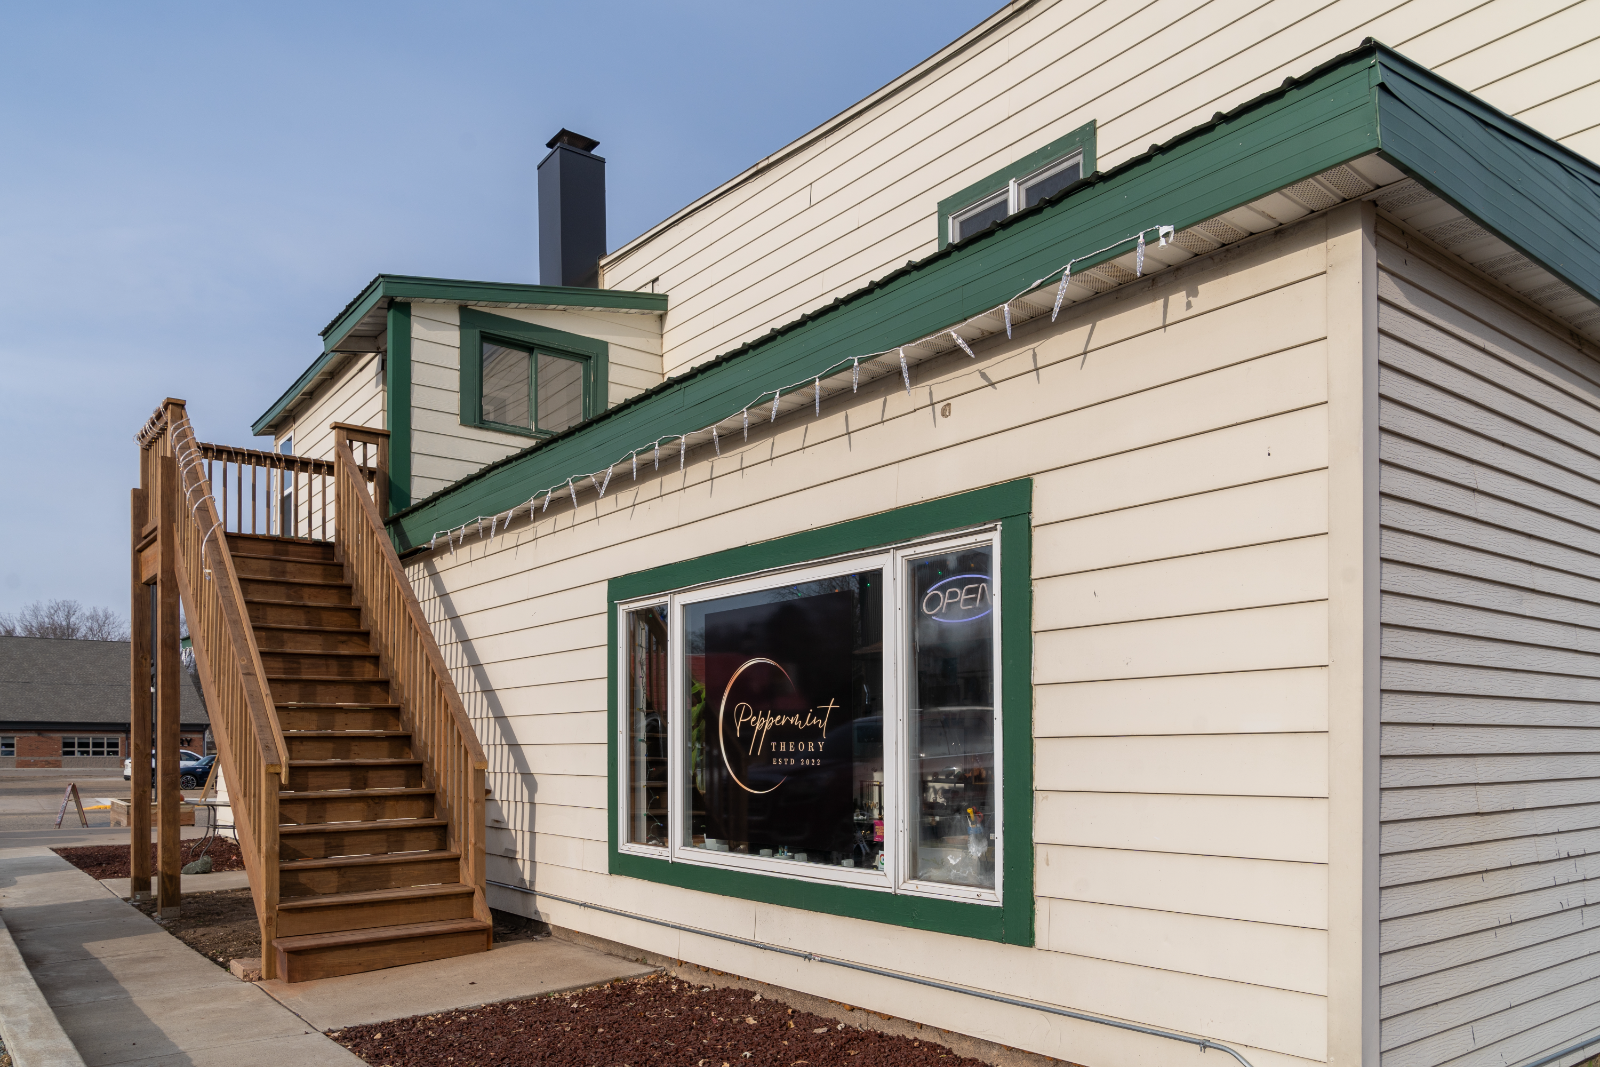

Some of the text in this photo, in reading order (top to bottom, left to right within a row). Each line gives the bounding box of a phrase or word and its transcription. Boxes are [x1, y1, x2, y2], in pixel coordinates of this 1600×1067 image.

[922, 583, 992, 615] OPEN
[733, 697, 840, 755] Peppermint
[770, 741, 825, 752] THEORY
[772, 757, 795, 765] ESTD
